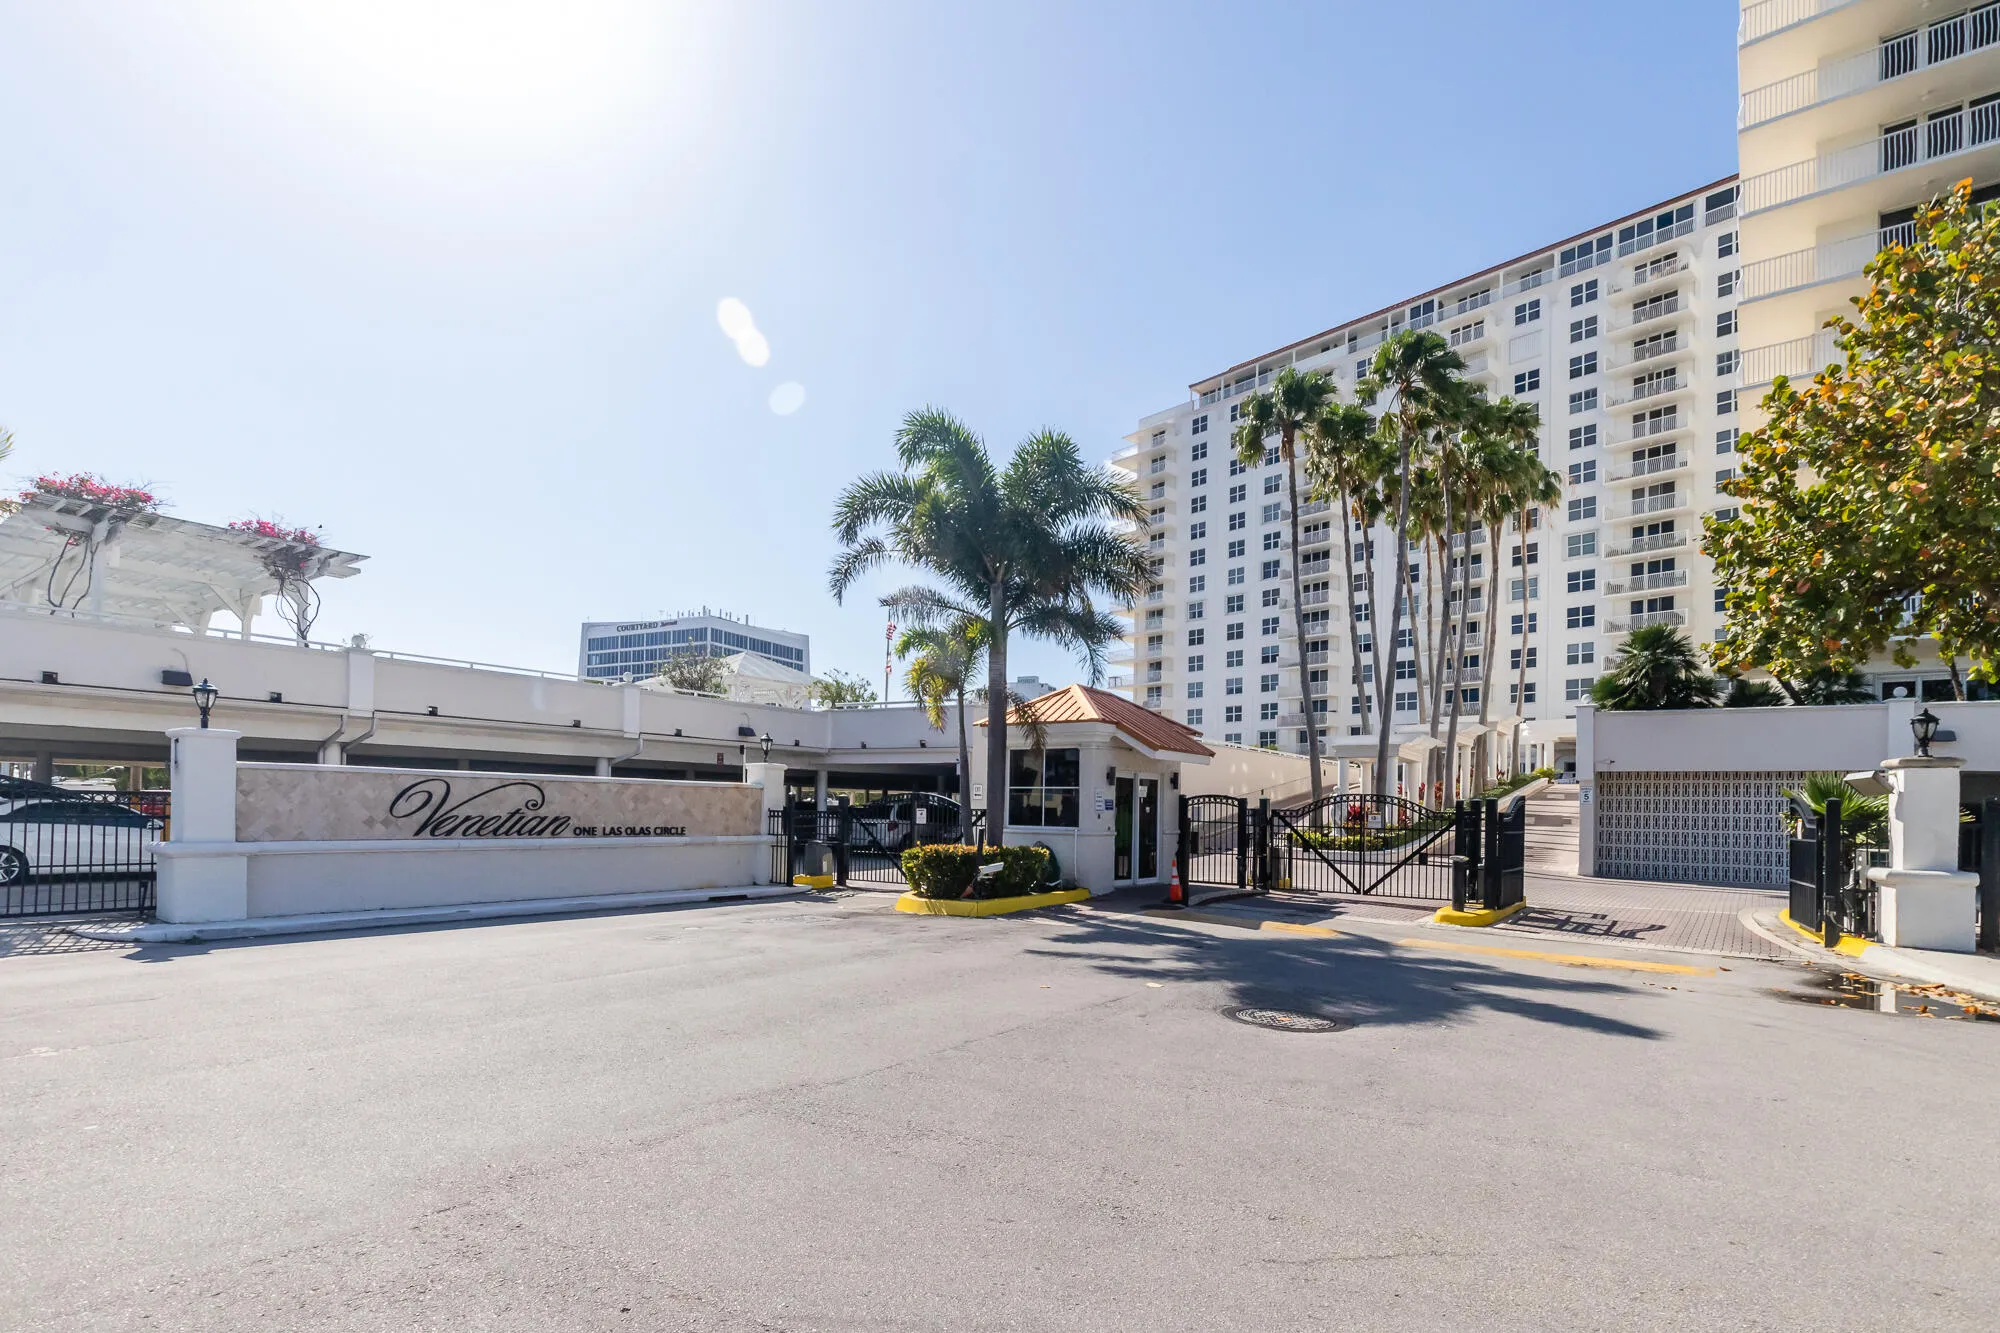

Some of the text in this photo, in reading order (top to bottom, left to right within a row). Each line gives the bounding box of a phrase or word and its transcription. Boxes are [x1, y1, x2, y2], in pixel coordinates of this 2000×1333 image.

[1583, 793, 1590, 801] 5
[389, 778, 571, 837] Venetian
[573, 826, 686, 836] ONE LAS OLAS CIRCLE
